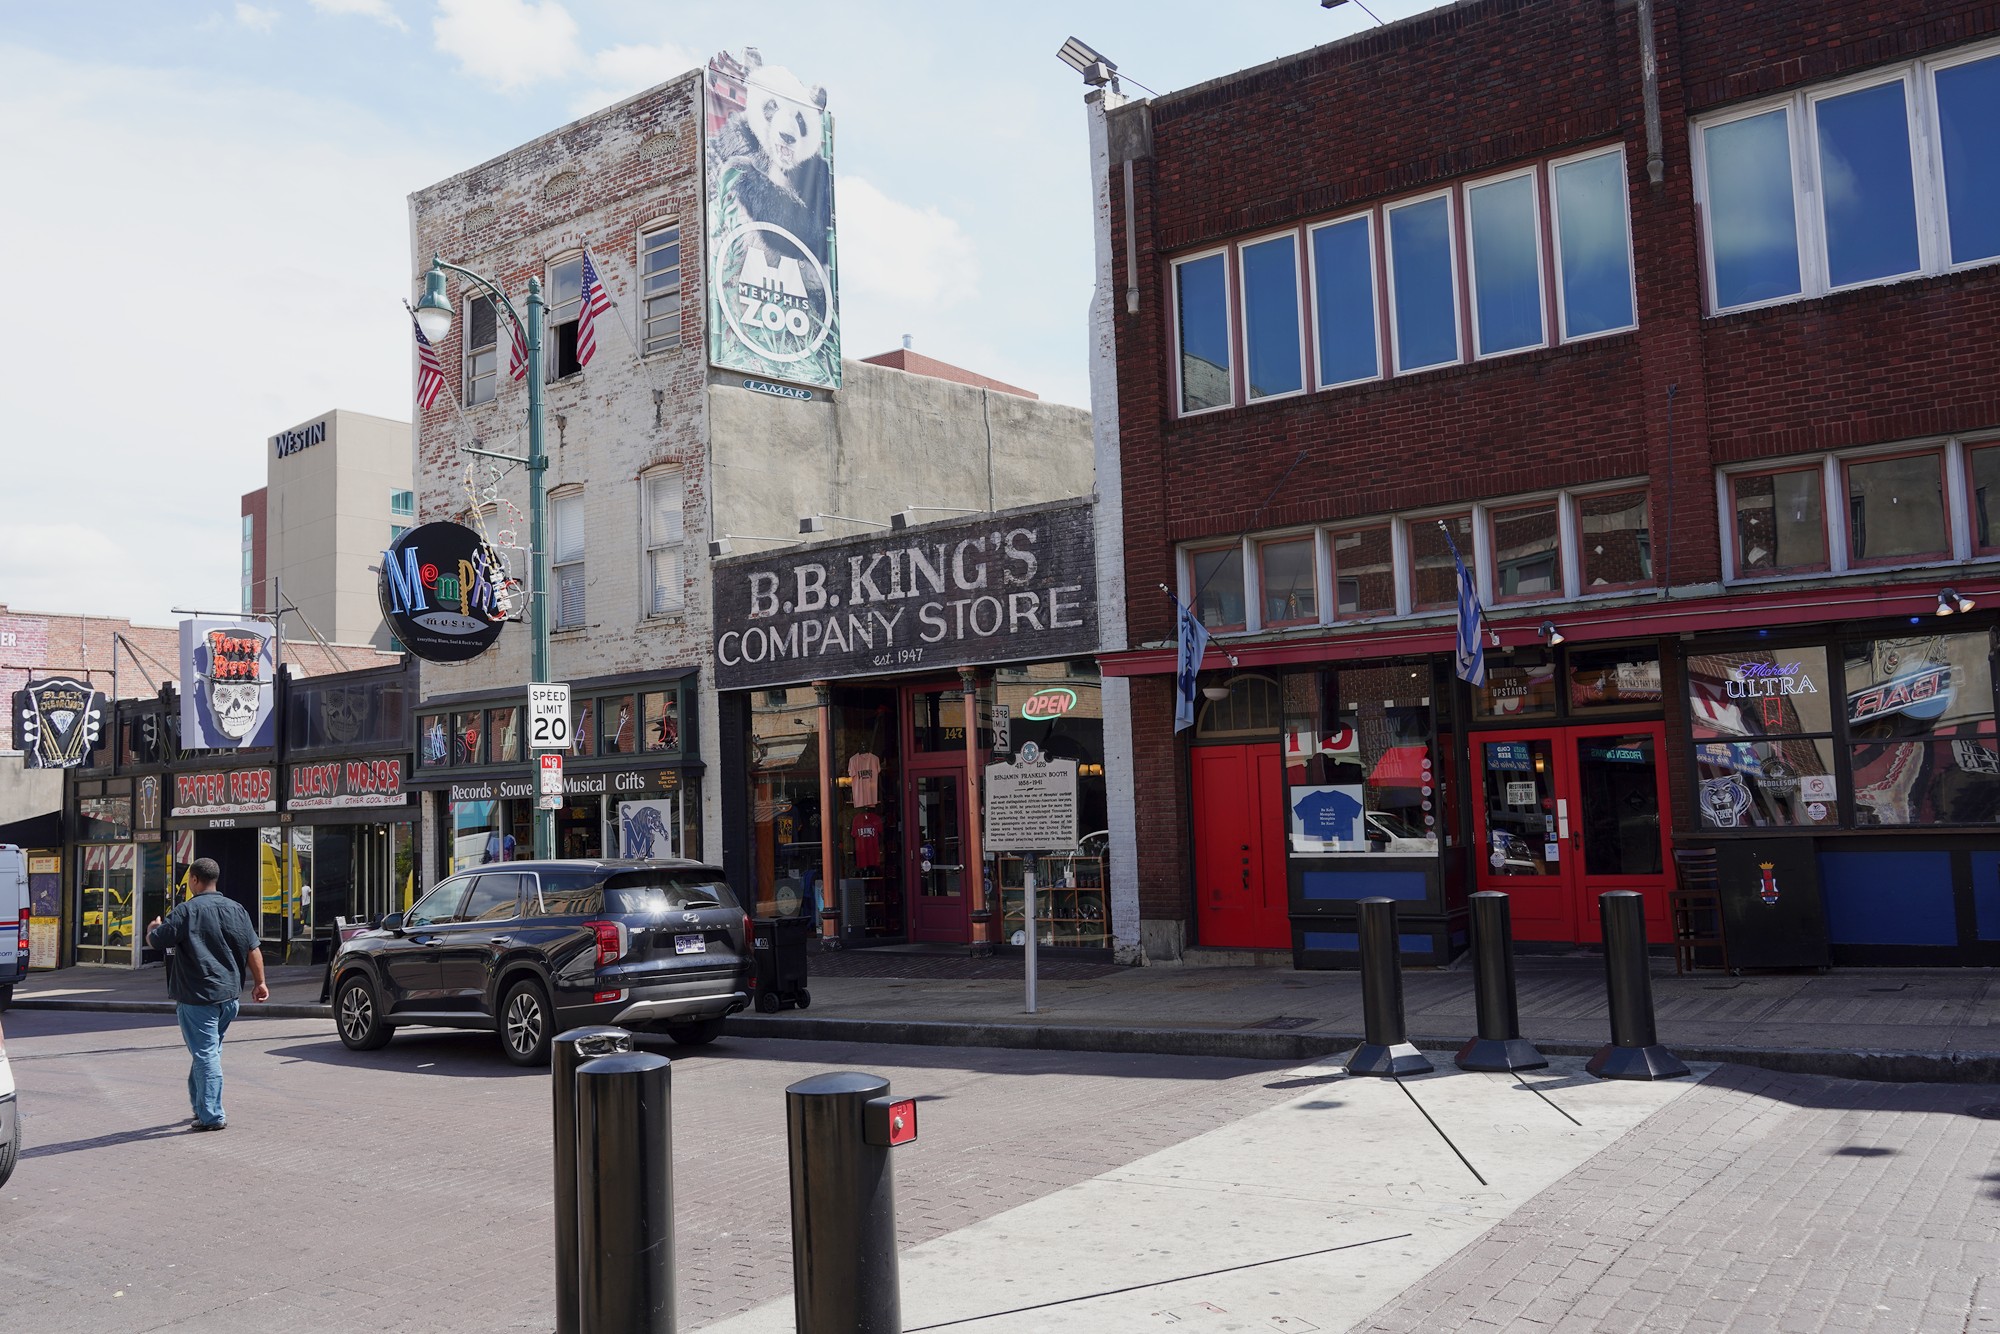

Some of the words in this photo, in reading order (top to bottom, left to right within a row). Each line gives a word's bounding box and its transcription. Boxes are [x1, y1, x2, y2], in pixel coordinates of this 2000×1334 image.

[738, 283, 810, 310] MEMPHIS
[739, 297, 810, 338] ZOO
[748, 382, 806, 399] LAMAR
[275, 422, 326, 459] WESTIN
[748, 563, 840, 620] B.B.
[847, 527, 1039, 606] KING'S
[384, 546, 517, 621] Memph
[718, 607, 904, 667] COMPANY
[919, 584, 1084, 643] STORE
[873, 653, 894, 666] est.
[897, 648, 923, 663] 1947
[1492, 686, 1528, 697] UPSTAIRS
[1504, 679, 1517, 687] 145
[1725, 675, 1818, 699] ULTRA
[42, 691, 82, 699] BLACK
[532, 691, 566, 701] SPEED
[40, 700, 84, 711] DIAMOND
[537, 705, 562, 714] LIMIT
[1025, 695, 1071, 715] OPEN
[535, 718, 566, 740] 20
[944, 728, 963, 740] 147
[1363, 717, 1401, 734] FOLLOW
[1366, 735, 1380, 750] US
[1381, 733, 1394, 748] ON
[1368, 748, 1402, 765] SOCIAL
[178, 774, 225, 804] TATER
[230, 769, 271, 803] RED'S
[293, 763, 340, 797] LUCKY
[346, 760, 400, 795] MOJOS
[452, 782, 491, 799] Records
[500, 782, 533, 797] Souve
[562, 774, 606, 793] Musical
[615, 772, 645, 790] Gifts
[1758, 778, 1801, 788] MEDDLESOME
[291, 799, 332, 808] COLLECTABLES
[345, 797, 364, 805] OTHER
[209, 819, 235, 828] ENTER
